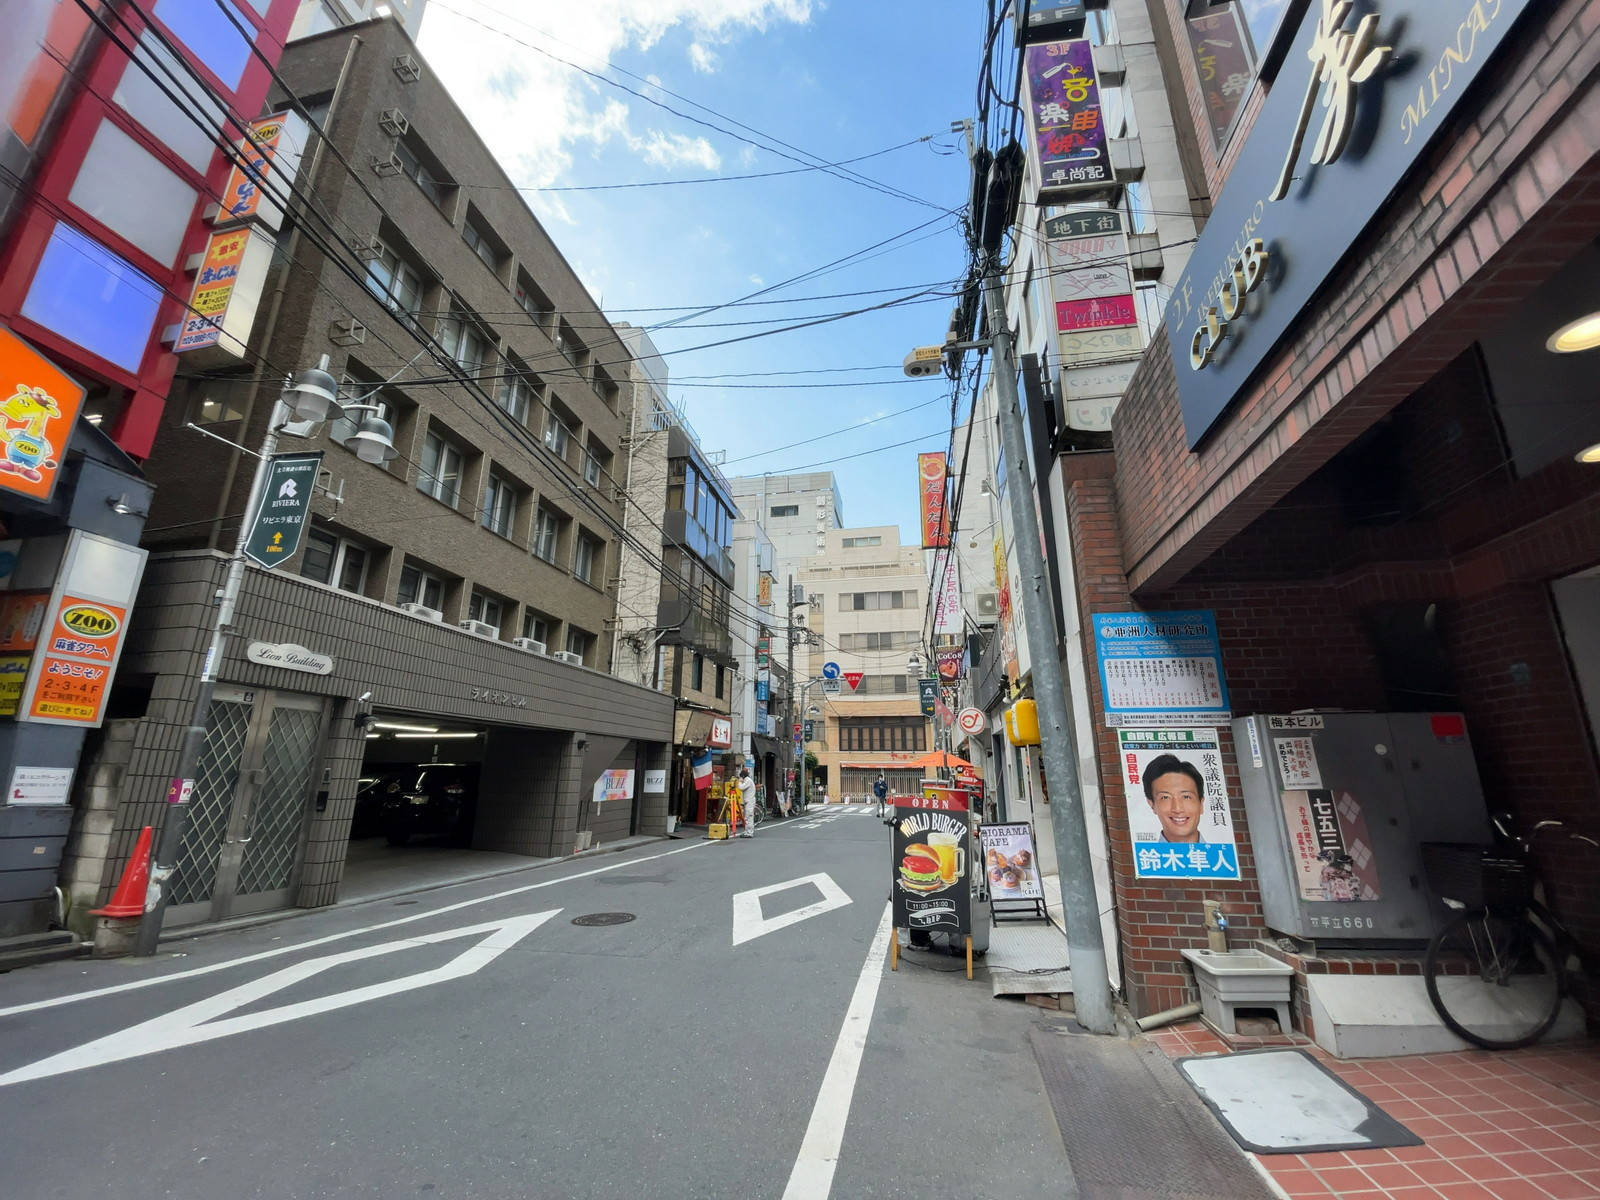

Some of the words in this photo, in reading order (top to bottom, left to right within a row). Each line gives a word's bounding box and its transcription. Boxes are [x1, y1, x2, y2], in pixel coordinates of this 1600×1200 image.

[1046, 43, 1070, 56] 3F
[1046, 165, 1105, 184] 卓尚記
[1053, 215, 1115, 235] 地下街
[1173, 274, 1194, 333] 2F
[1060, 302, 1130, 326] Twinkle
[18, 443, 38, 454] ZOO
[272, 499, 300, 508] RIVIERA
[262, 515, 302, 524] リビエラ東京
[69, 612, 112, 631] ZOO
[54, 638, 109, 657] 麻雀タワーへ
[256, 648, 282, 661] Lion
[283, 652, 325, 671] Building
[471, 688, 528, 707] ライオンビル
[1270, 716, 1321, 728] 梅本ビル
[1127, 731, 1154, 741] 自民党
[1126, 753, 1140, 785] 自民党
[605, 777, 625, 790] BUZZ
[1203, 753, 1227, 827] 衆議院議員
[912, 798, 949, 810] OPEN
[900, 813, 930, 839] WORLD
[931, 812, 968, 842] BURGER
[1313, 798, 1342, 851] 七五三
[982, 838, 1009, 847] CAFE
[1138, 848, 1235, 873] 鈴木隼人
